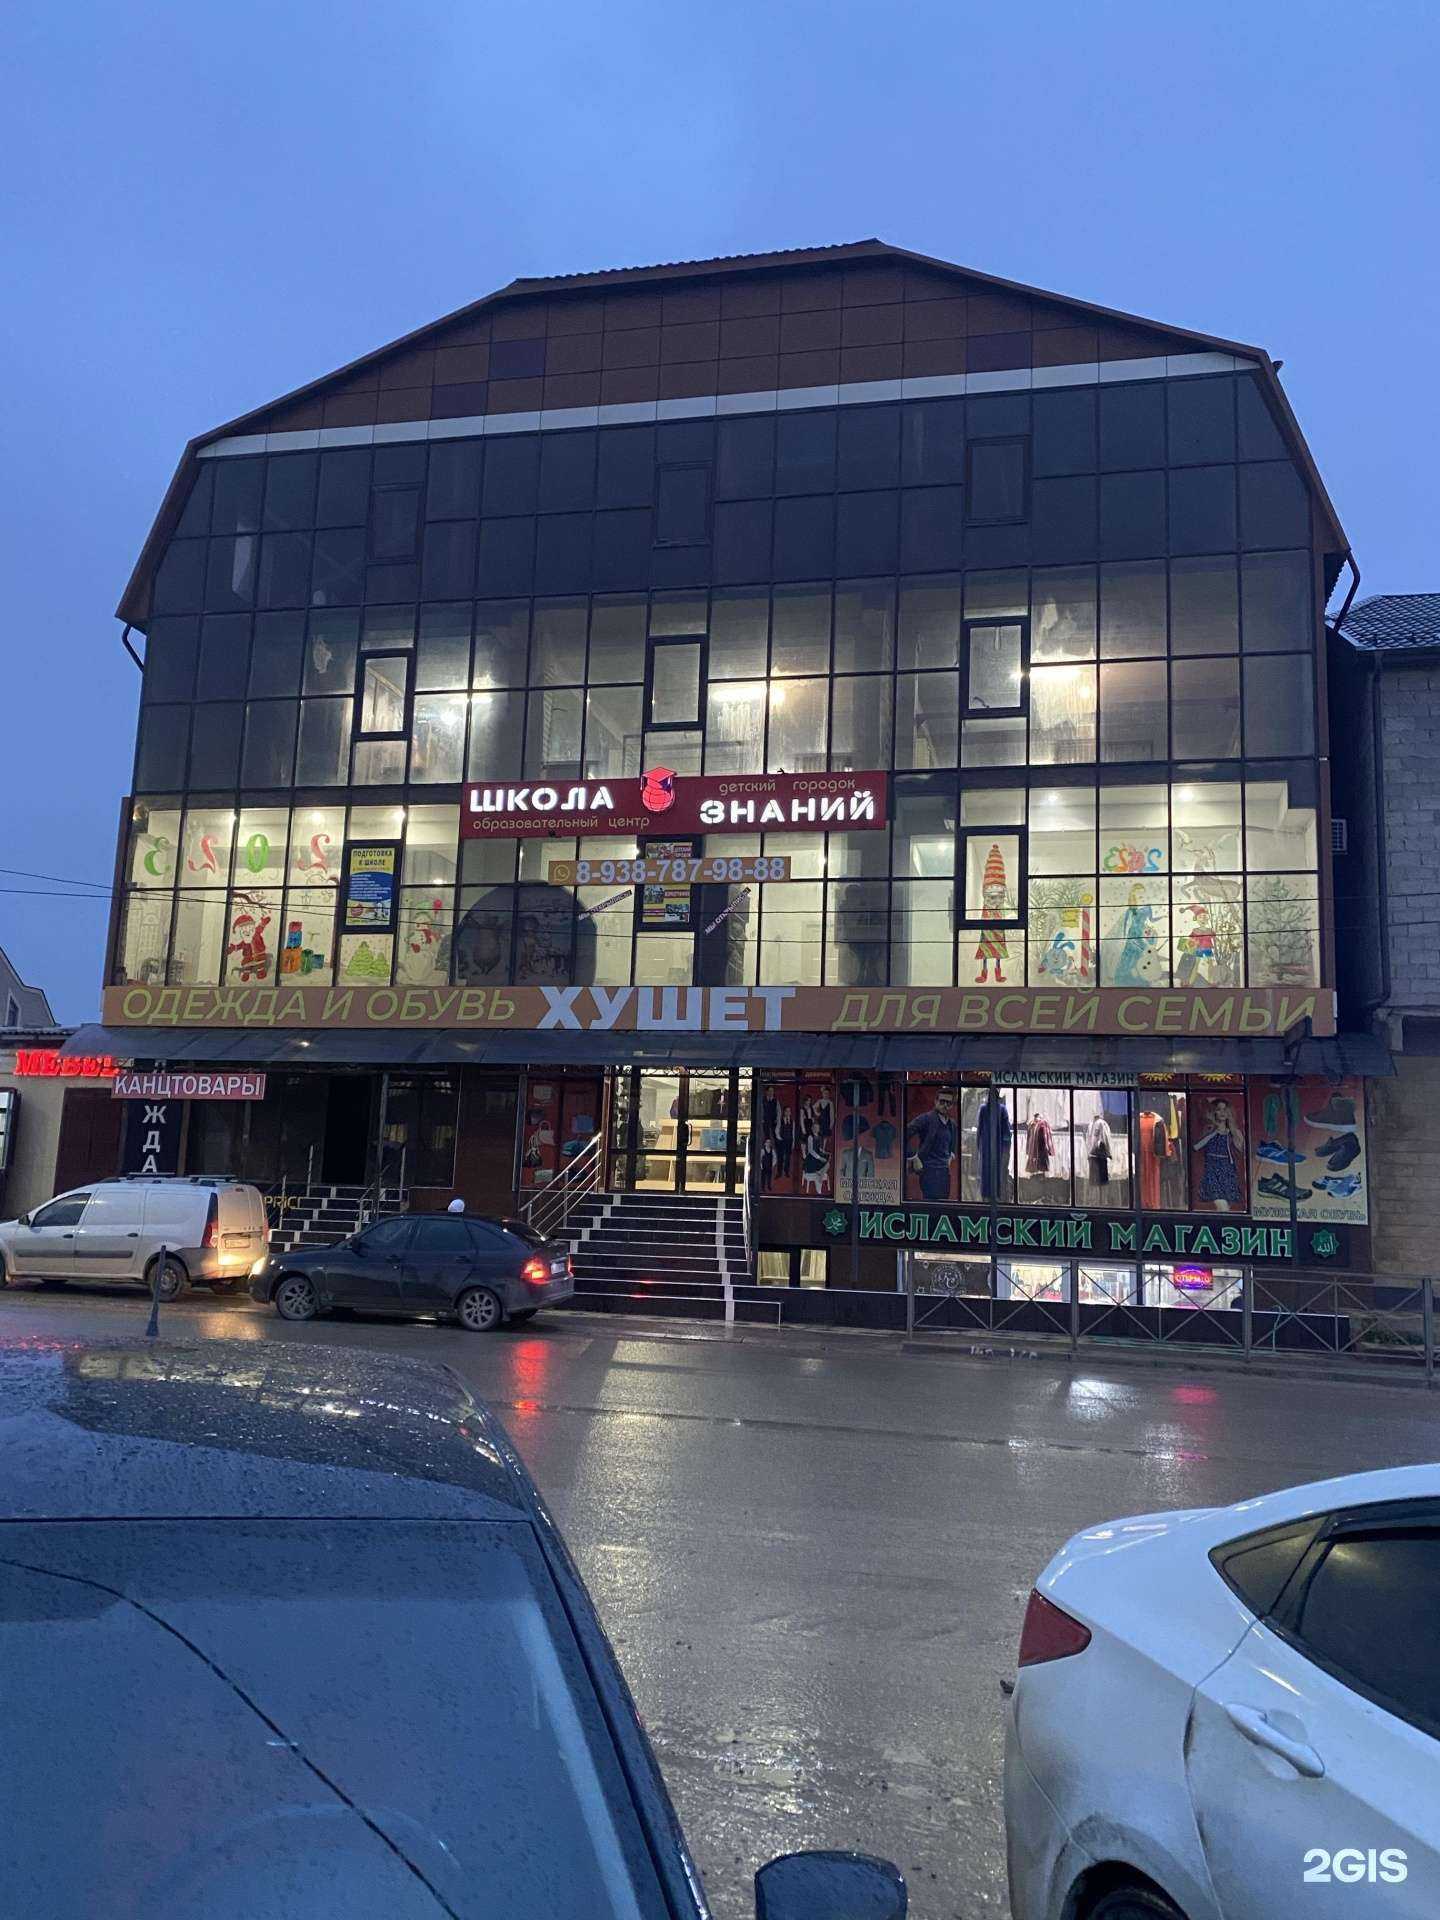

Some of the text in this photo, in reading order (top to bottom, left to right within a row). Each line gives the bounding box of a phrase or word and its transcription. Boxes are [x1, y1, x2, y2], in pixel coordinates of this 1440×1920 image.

[469, 785, 615, 813] ШКОЛА
[719, 778, 856, 796] детский городок
[699, 790, 875, 825] ЗНАНИЙ
[473, 814, 650, 833] образовательный центр
[575, 857, 786, 884] 8-938-787-98-88
[122, 986, 1317, 1033] ОДЕЖДА И ОБУВЬ ХУШЕТ ДЛЯ ВСЕЙ СЕМЬИ
[115, 1075, 261, 1098] КАНЦТОВАРЫ
[1075, 1071, 1134, 1085] МАГАЗИН
[859, 1211, 1293, 1257] ИСЛАМСКИЙ МАГАЗИН
